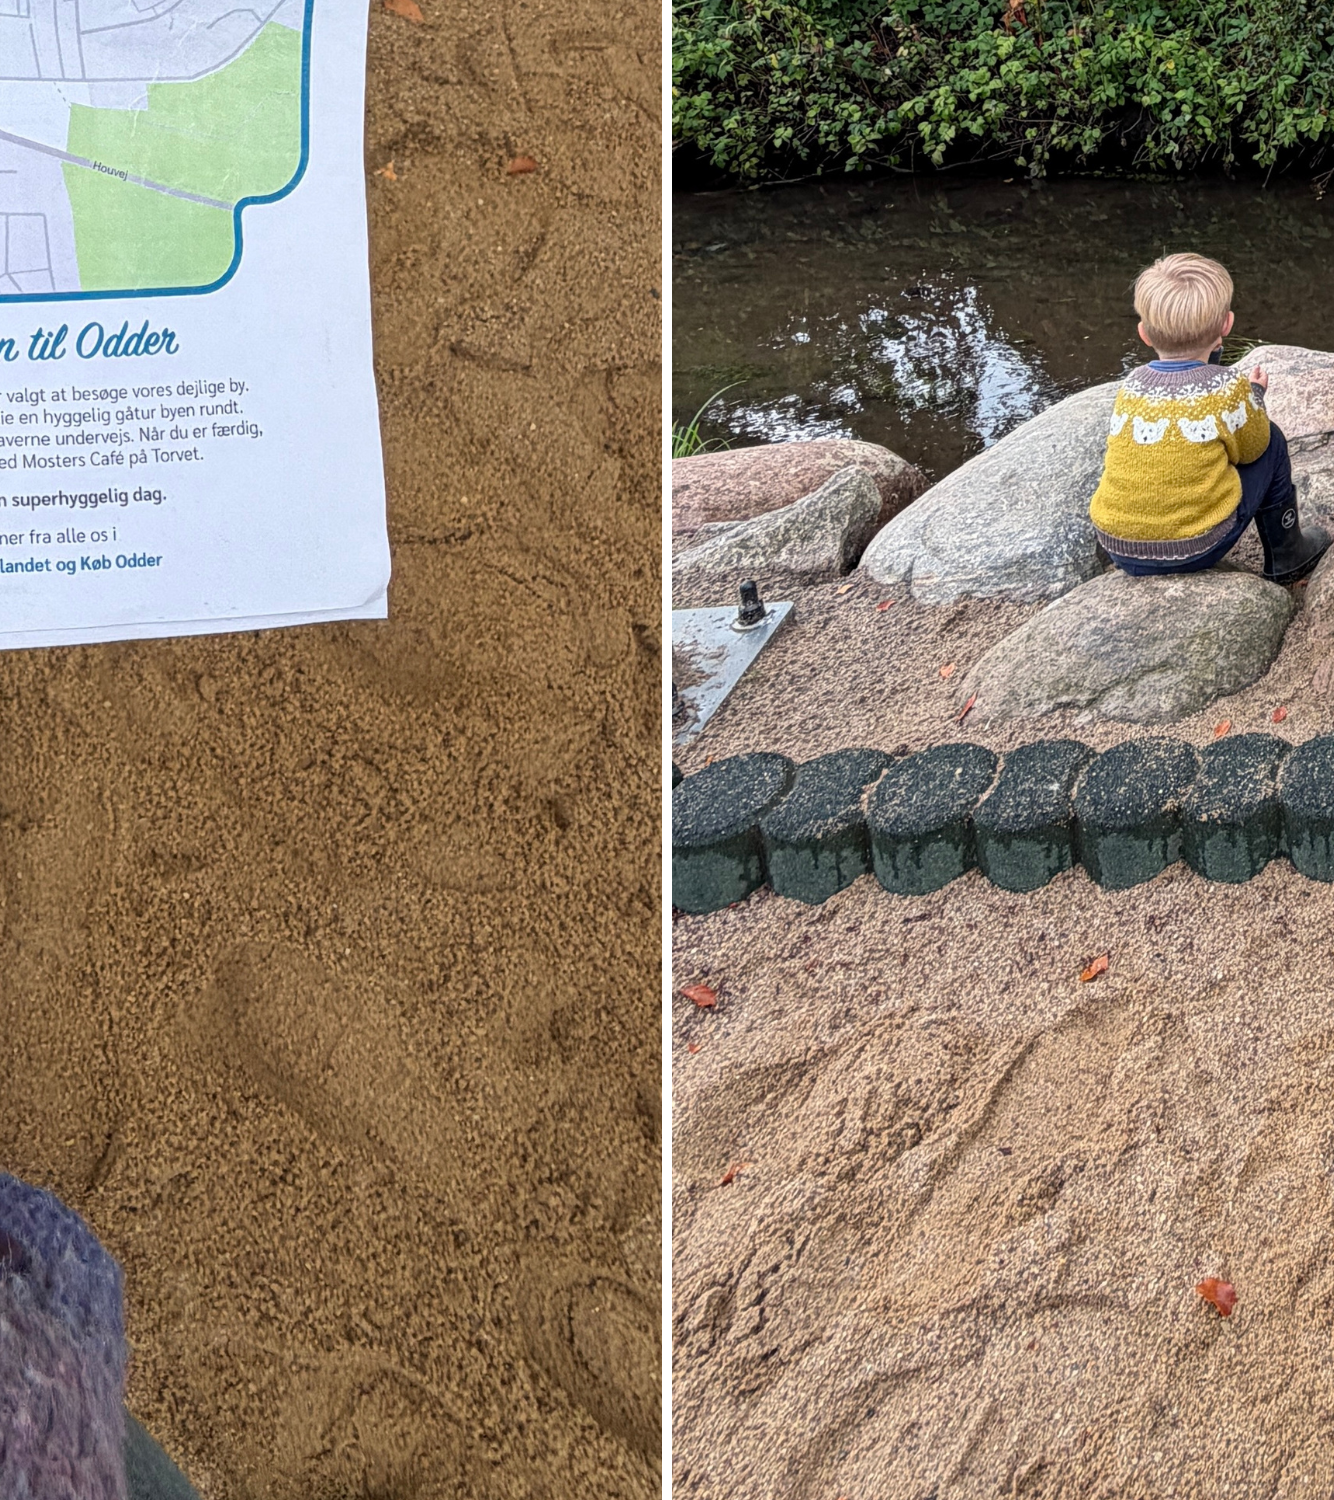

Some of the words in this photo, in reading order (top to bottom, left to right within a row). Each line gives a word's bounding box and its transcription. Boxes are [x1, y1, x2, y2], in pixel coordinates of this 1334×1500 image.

[93, 161, 128, 181] Houvej
[28, 324, 68, 360] til
[76, 320, 179, 359] Odder
[7, 388, 46, 406] valgt
[52, 388, 67, 401] at
[72, 386, 127, 403] besøge
[132, 386, 172, 398] vores
[177, 380, 225, 398] dejlige
[230, 378, 249, 395] by.
[19, 414, 38, 424] en
[44, 408, 110, 427] hyggelig
[116, 406, 156, 425] gåtur
[161, 404, 195, 421] byen
[200, 399, 243, 416] rundt.
[56, 429, 134, 446] undervejs.
[140, 427, 165, 441] Når
[170, 425, 188, 440] du
[193, 427, 207, 438] er
[212, 420, 262, 438] færdig,
[23, 454, 85, 468] Mosters
[90, 451, 124, 466] Café
[130, 449, 147, 468] på
[151, 447, 203, 462] Torvet.
[12, 488, 128, 511] superhyggelig
[133, 487, 166, 505] dag.
[30, 530, 51, 544] fra
[57, 528, 85, 543] alle
[91, 531, 108, 542] os
[113, 527, 116, 541] i
[56, 561, 76, 575] og
[81, 555, 111, 570] Køb
[116, 553, 162, 568] Odder
